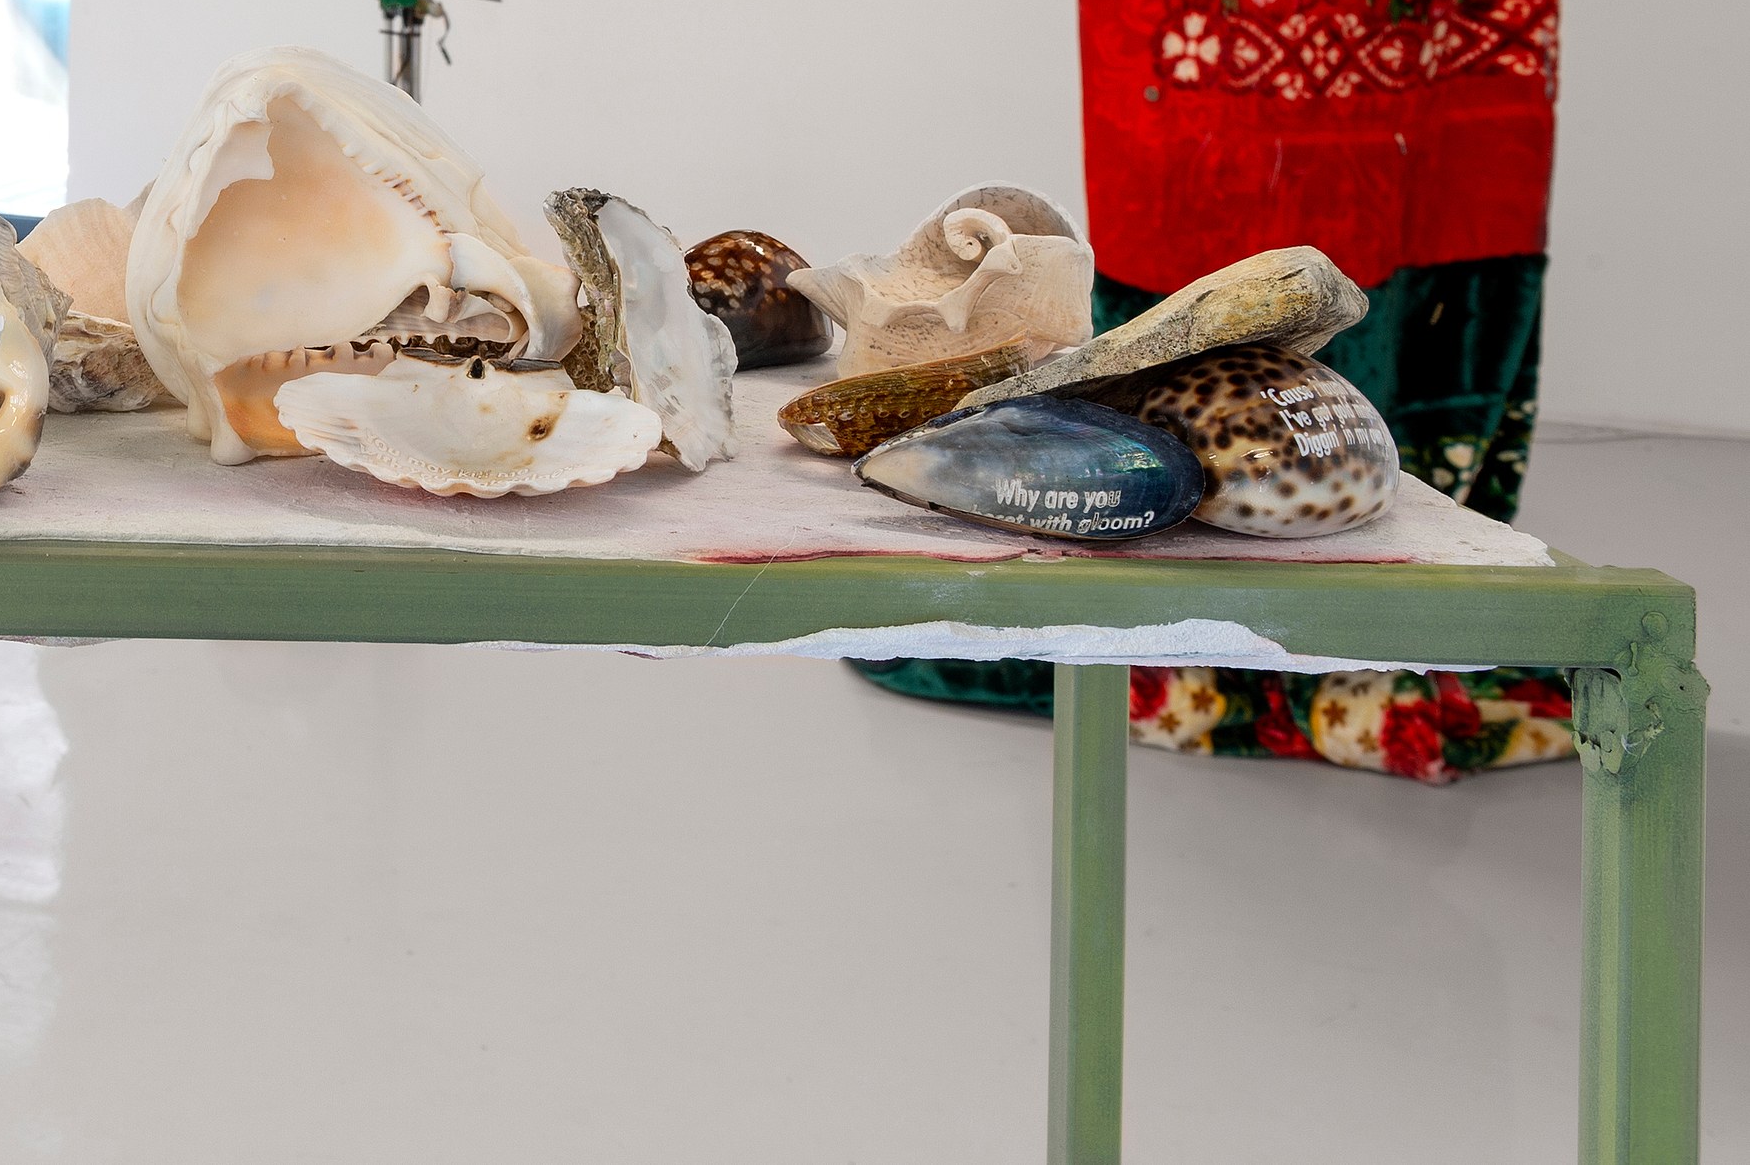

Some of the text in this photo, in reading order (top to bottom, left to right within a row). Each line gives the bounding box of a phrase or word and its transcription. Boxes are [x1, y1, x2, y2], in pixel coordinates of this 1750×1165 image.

[1279, 408, 1312, 431] I've
[995, 479, 1122, 513] Why are you
[1029, 512, 1073, 531] with
[1077, 510, 1155, 533] gloom?
